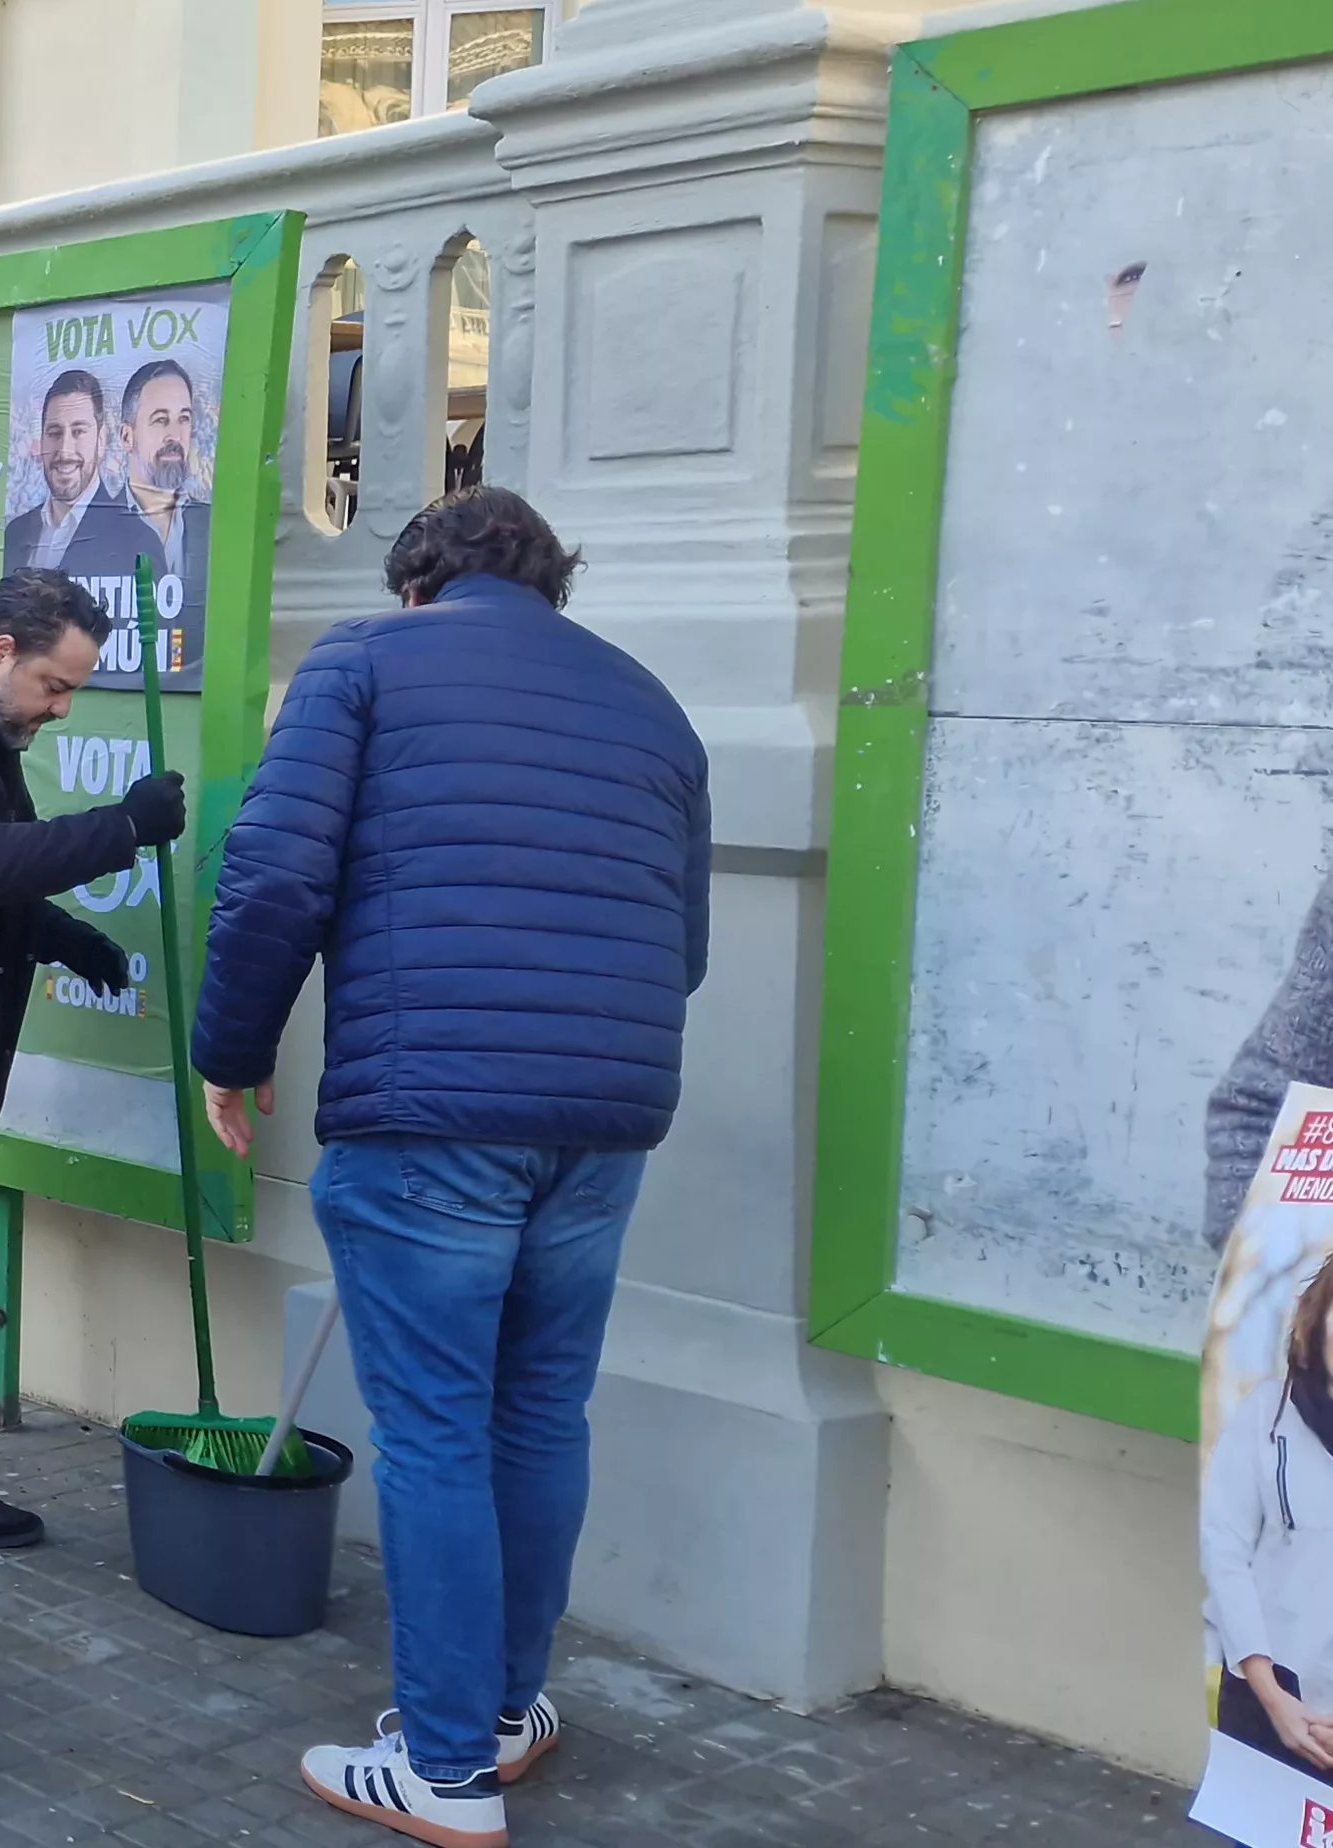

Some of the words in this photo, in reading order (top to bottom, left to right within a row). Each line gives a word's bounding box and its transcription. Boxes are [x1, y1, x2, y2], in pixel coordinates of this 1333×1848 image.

[45, 314, 114, 362] VOTA
[127, 306, 202, 351] VOX
[57, 735, 154, 796] VOTA
